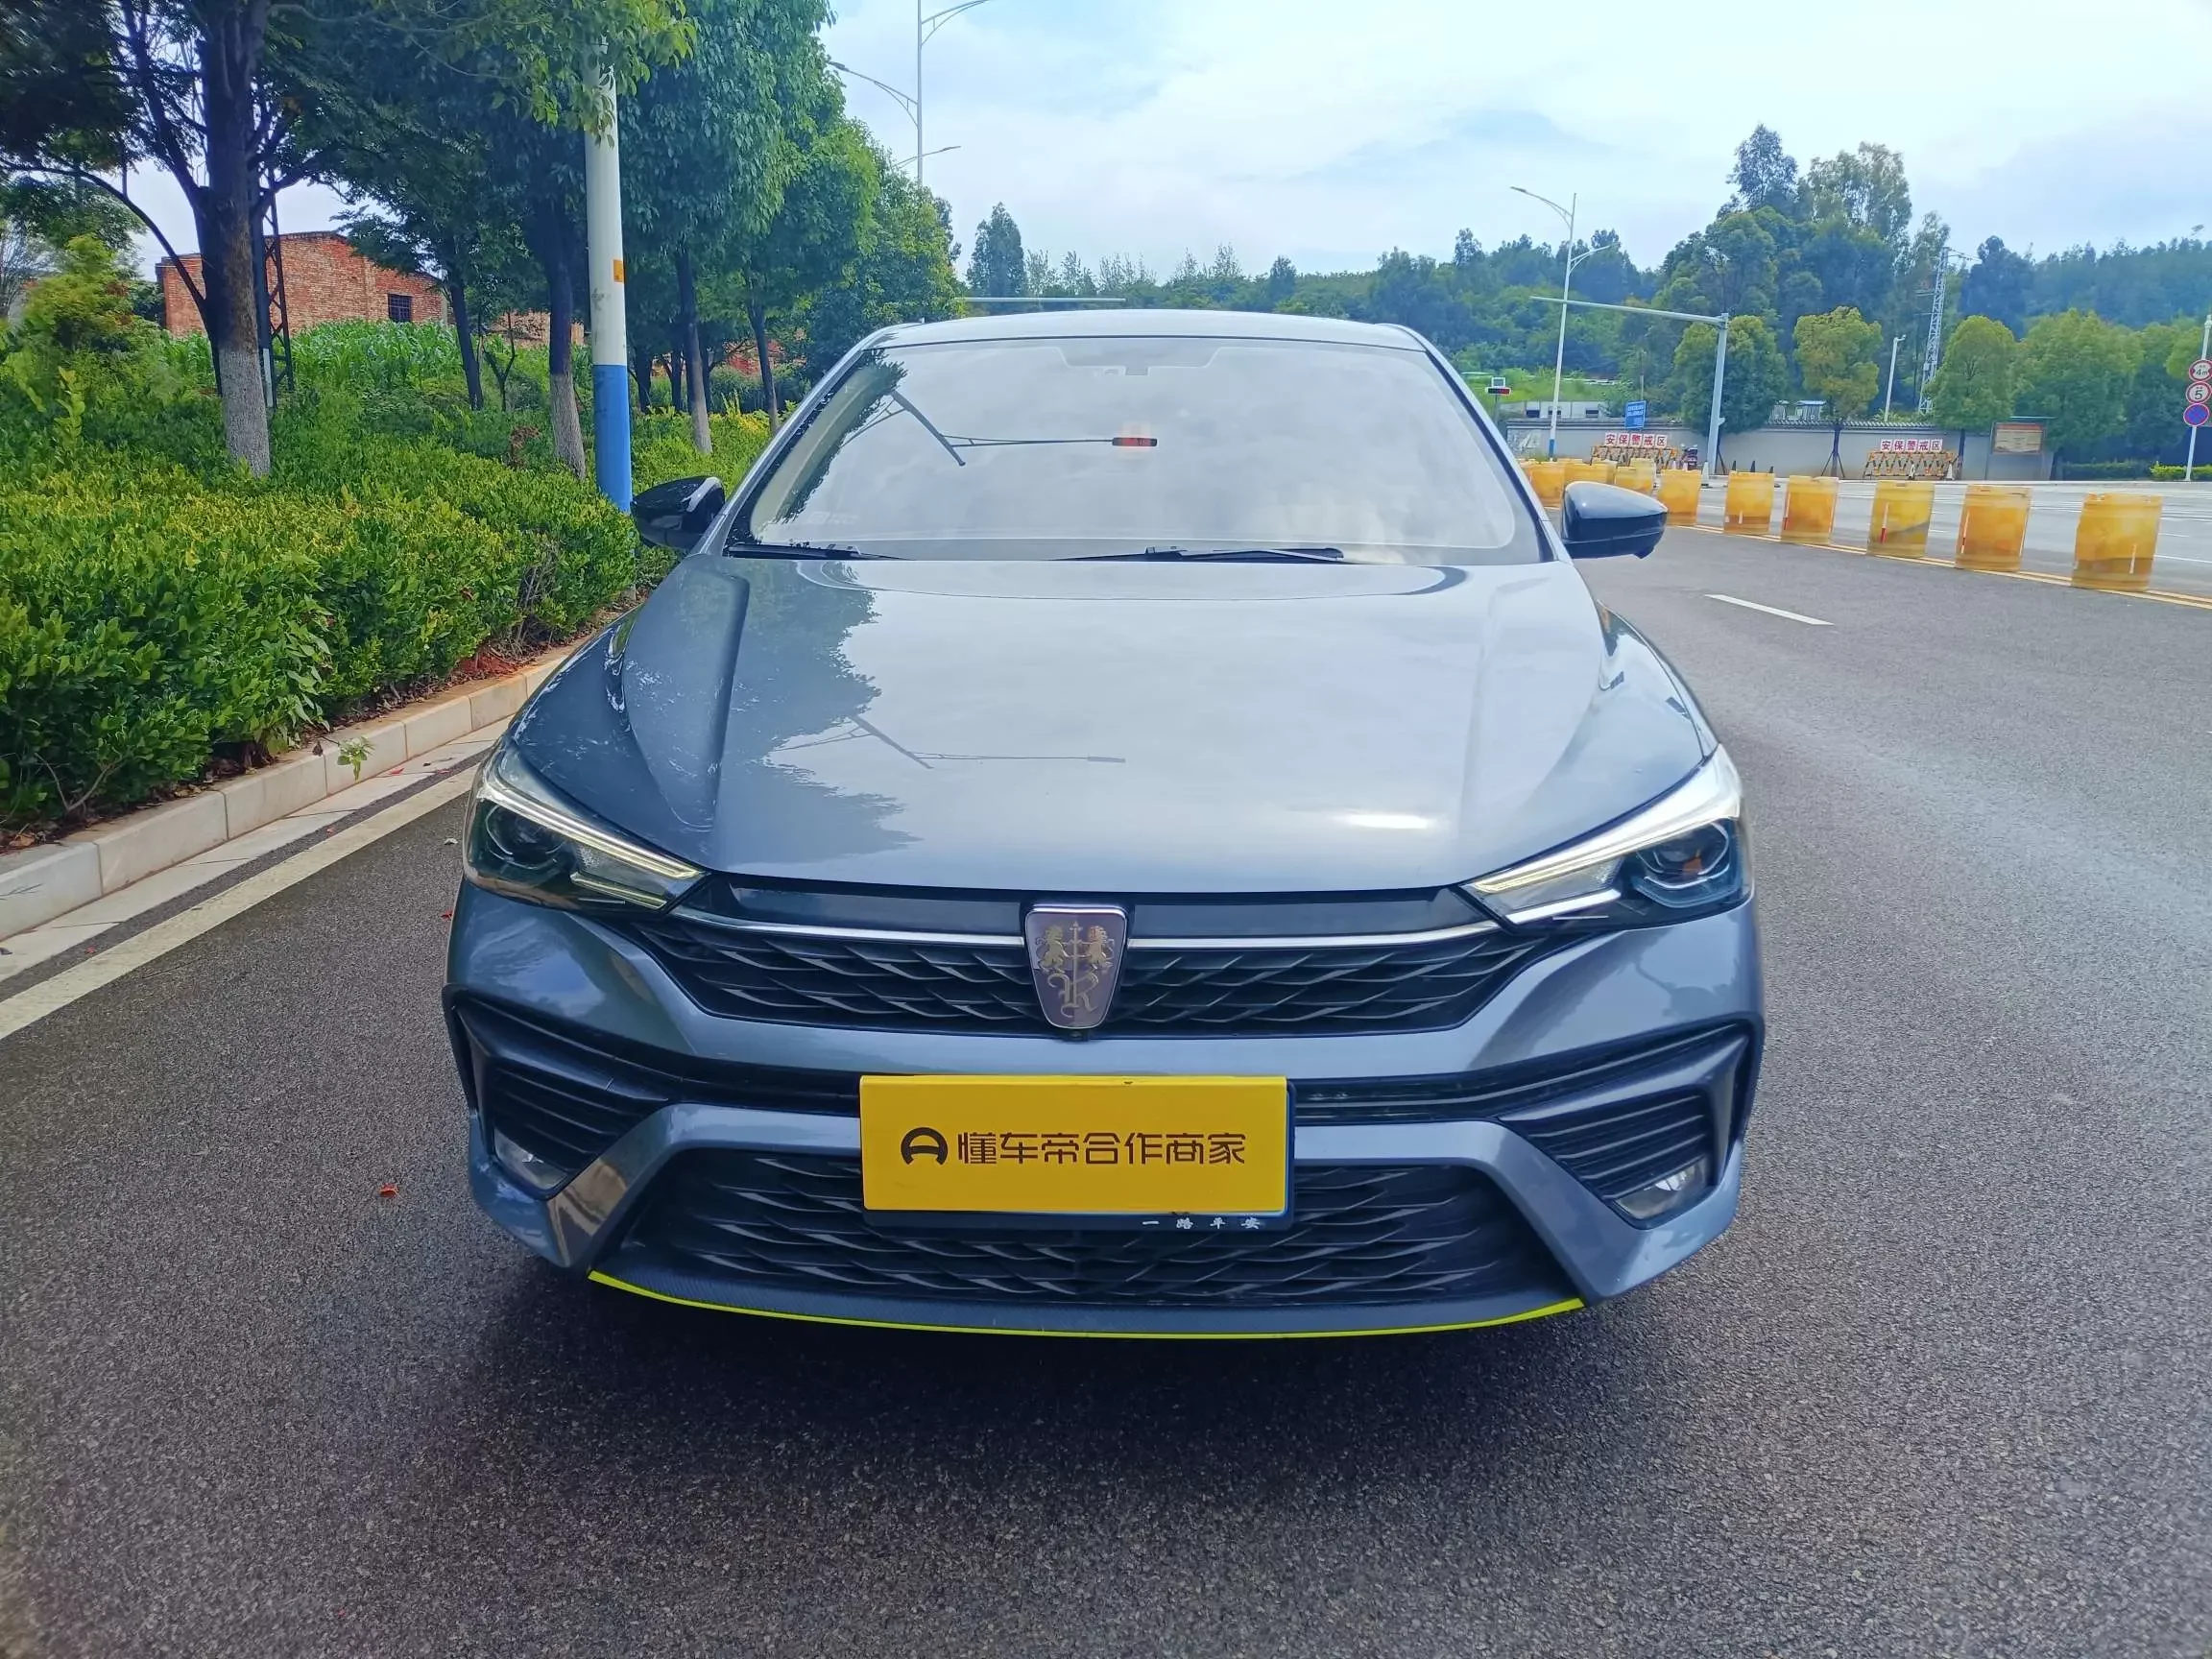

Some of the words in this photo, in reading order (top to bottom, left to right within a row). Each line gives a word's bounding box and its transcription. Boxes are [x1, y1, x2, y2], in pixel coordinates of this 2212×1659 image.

[1605, 434, 1667, 446] 安保警戒区
[1882, 440, 1940, 451] 安保警戒区
[957, 1131, 1246, 1166] 懂车帝合作商家
[1142, 1216, 1262, 1230] 一路平安
